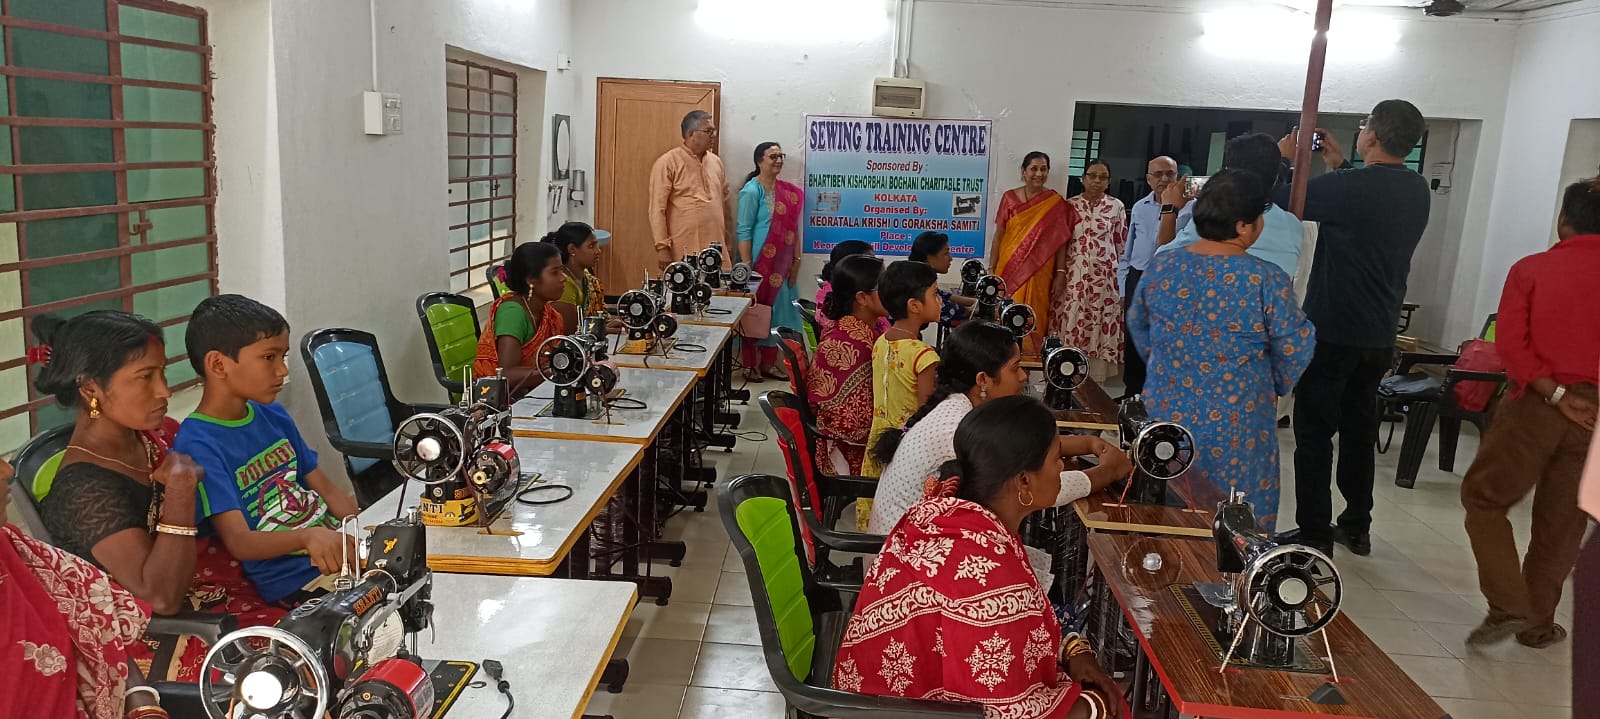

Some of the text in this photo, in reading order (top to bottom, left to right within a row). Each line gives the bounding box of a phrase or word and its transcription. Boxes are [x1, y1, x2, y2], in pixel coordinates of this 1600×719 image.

[810, 121, 987, 157] SEWING TRAINING CENTRE
[866, 160, 911, 172] Sponsored
[912, 162, 924, 174] By
[808, 173, 985, 192] BHARTIBEN KISHORBHAI BOGHANI CHARITABLE TRUST
[874, 193, 918, 203] KOLKATA
[863, 205, 927, 216] Organised By:
[809, 216, 859, 228] KEORATALA
[861, 218, 891, 228] KRISHI
[901, 219, 948, 230] GORAKSHA
[950, 220, 981, 231] SAMITI
[880, 232, 906, 240] Place
[813, 240, 837, 250] Keor
[882, 243, 912, 252] Develo
[950, 245, 975, 253] entre
[422, 503, 443, 514] NTI
